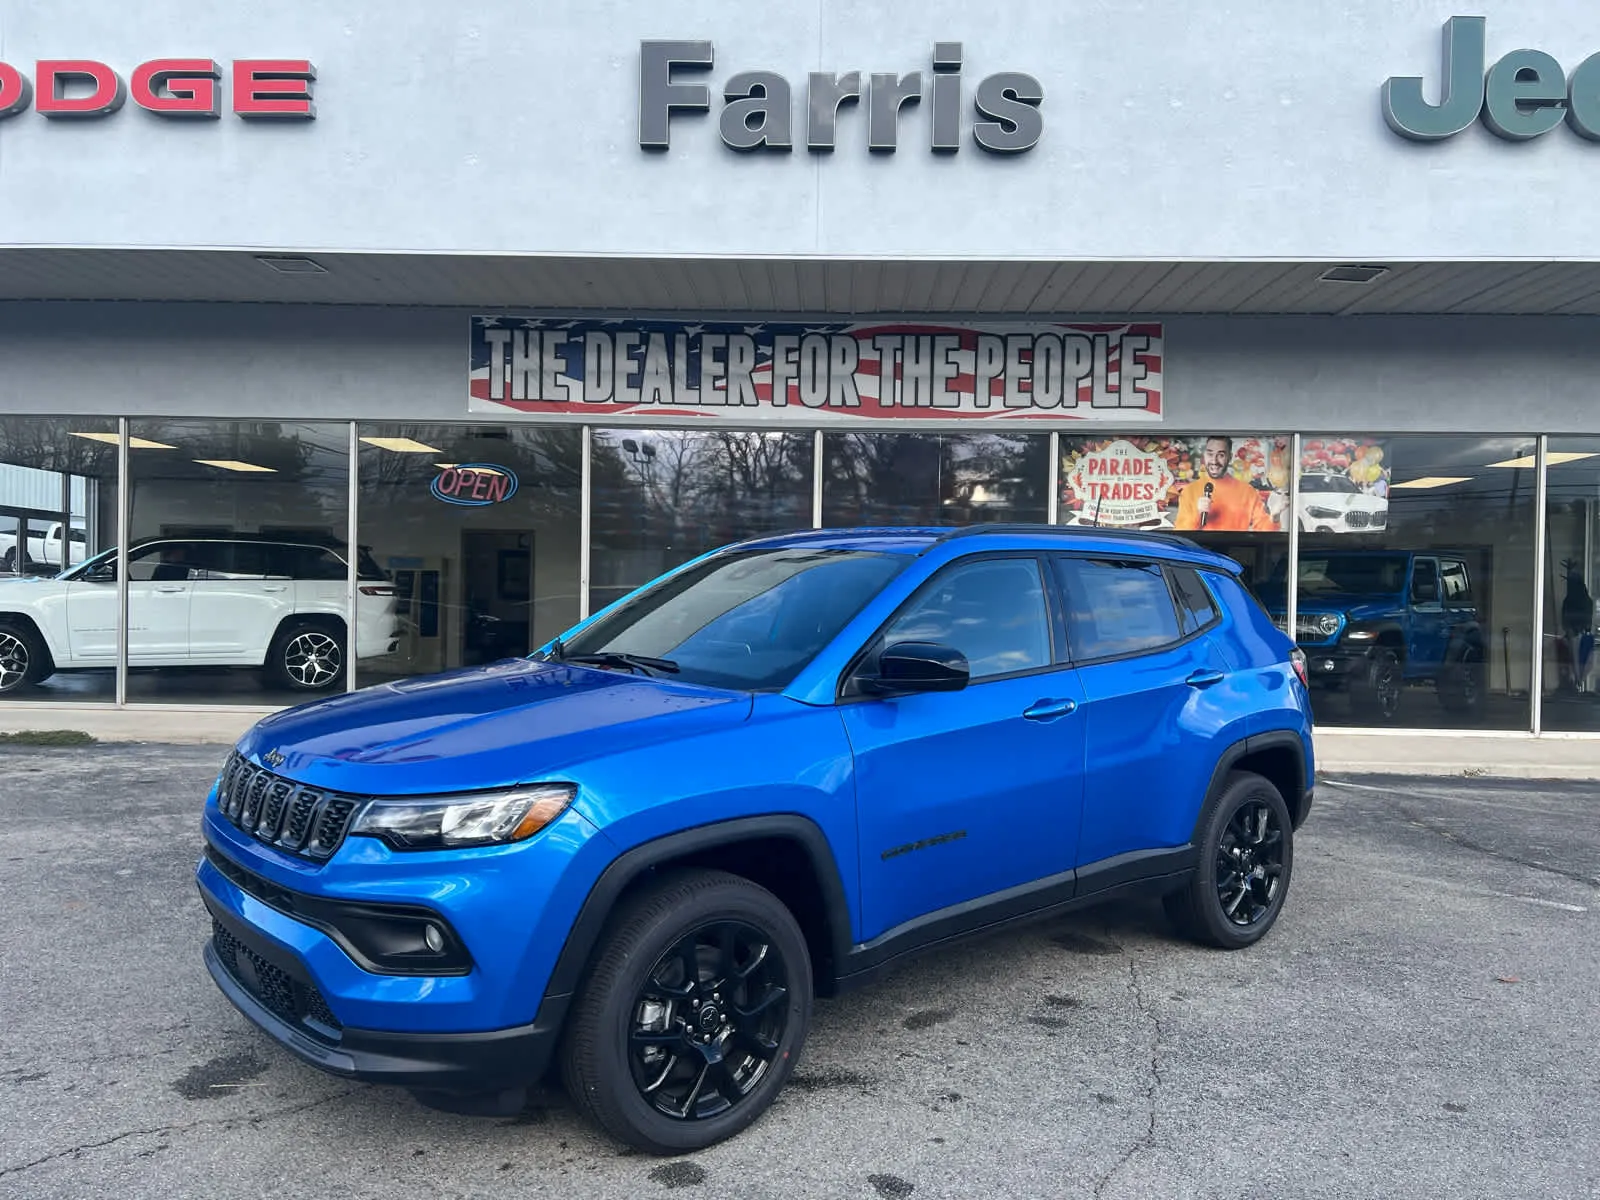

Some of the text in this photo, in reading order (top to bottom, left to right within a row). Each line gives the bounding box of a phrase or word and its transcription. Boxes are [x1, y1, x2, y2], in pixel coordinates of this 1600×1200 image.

[0, 59, 317, 120] DGE
[638, 40, 1044, 153] Farris
[485, 329, 1150, 409] THE DEALER FOR THE PEOPLE
[438, 467, 508, 502] OPEN
[1088, 457, 1154, 475] PARADE
[1088, 482, 1154, 500] TRADES
